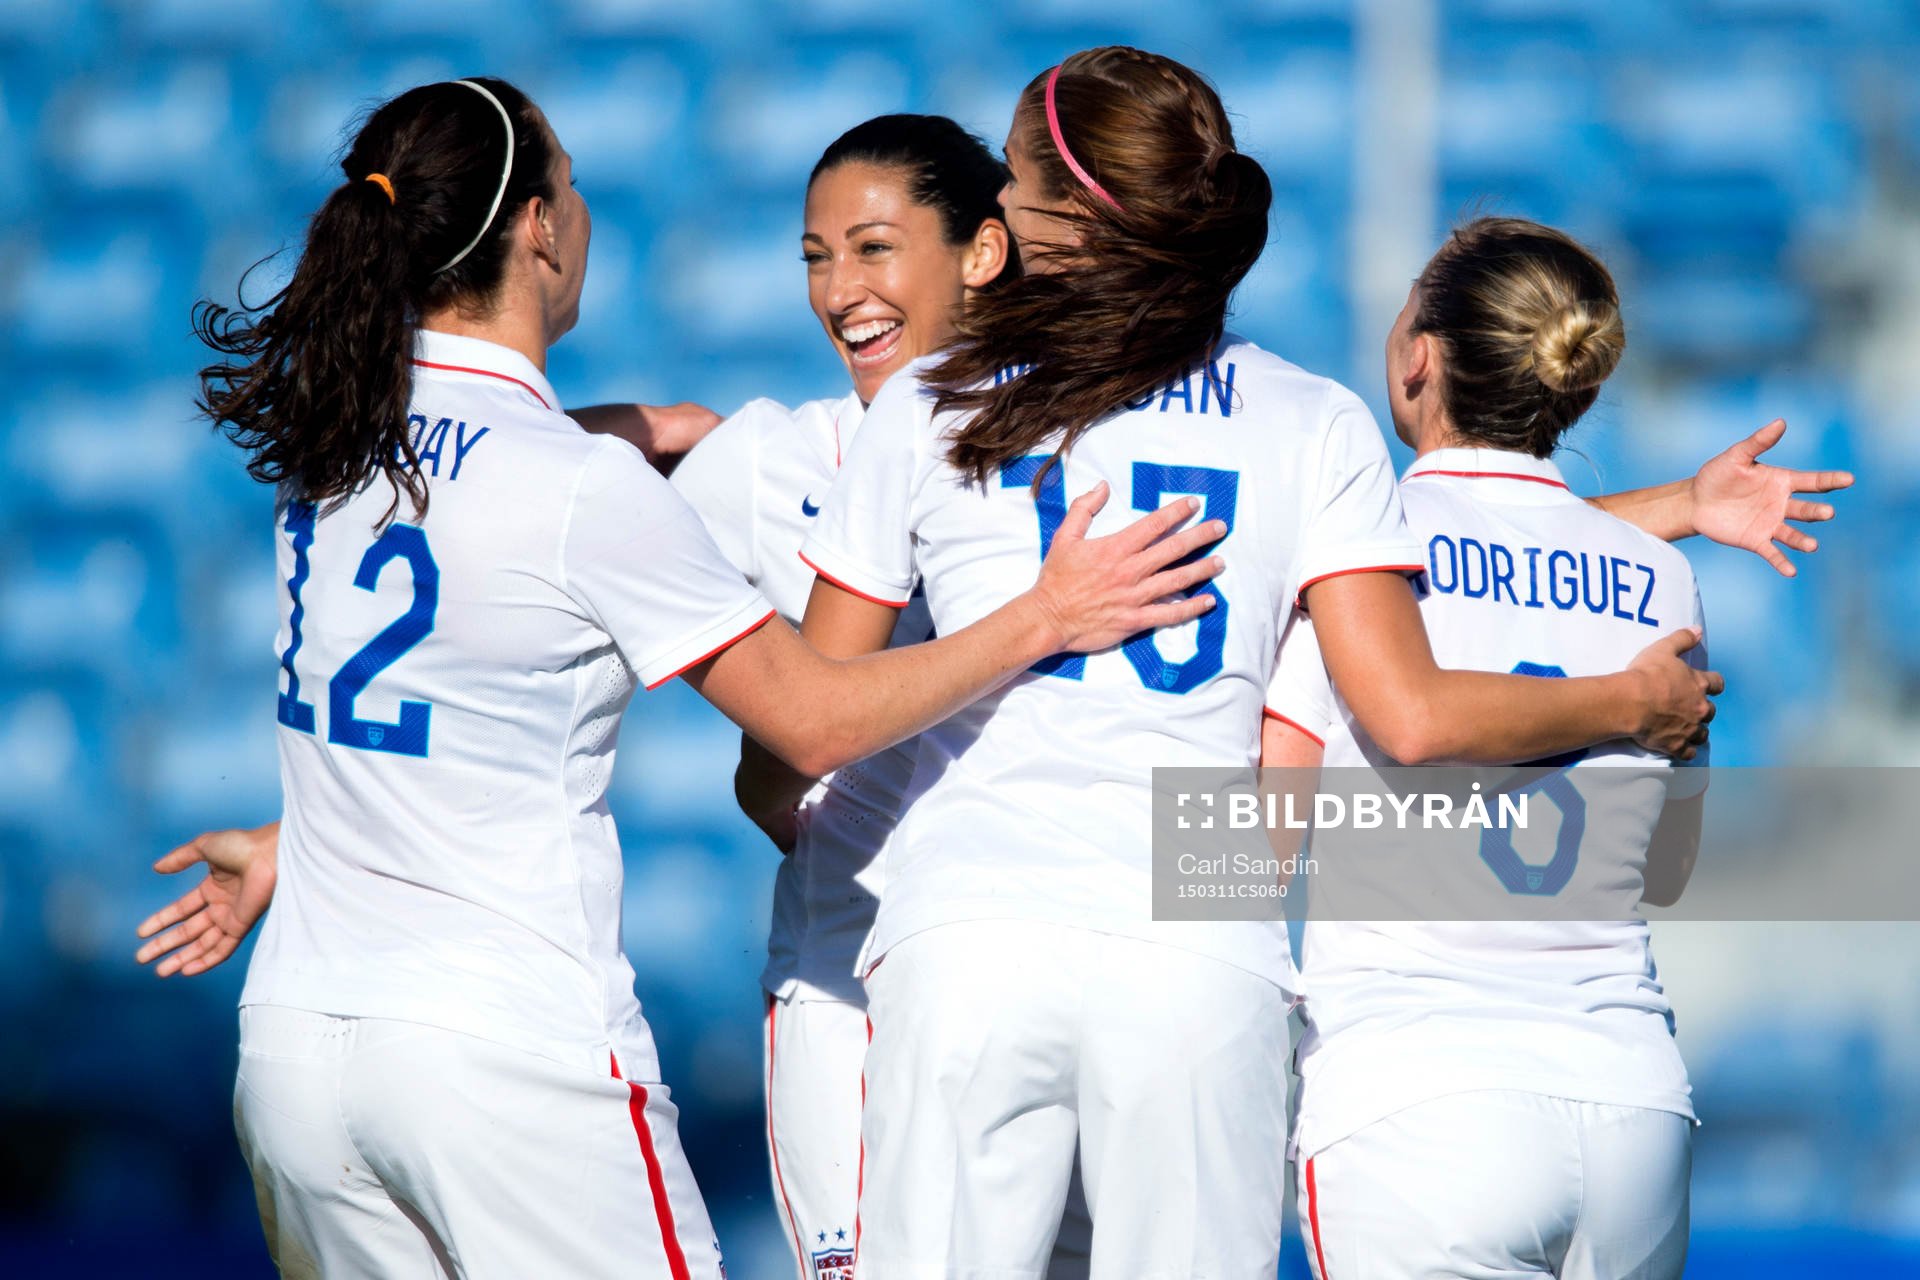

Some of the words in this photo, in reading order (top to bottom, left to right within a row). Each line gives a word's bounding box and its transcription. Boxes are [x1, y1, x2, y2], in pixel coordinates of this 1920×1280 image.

[374, 414, 490, 480] DAY
[1409, 534, 1659, 627] ODRIGUEZ
[277, 500, 440, 758] 12
